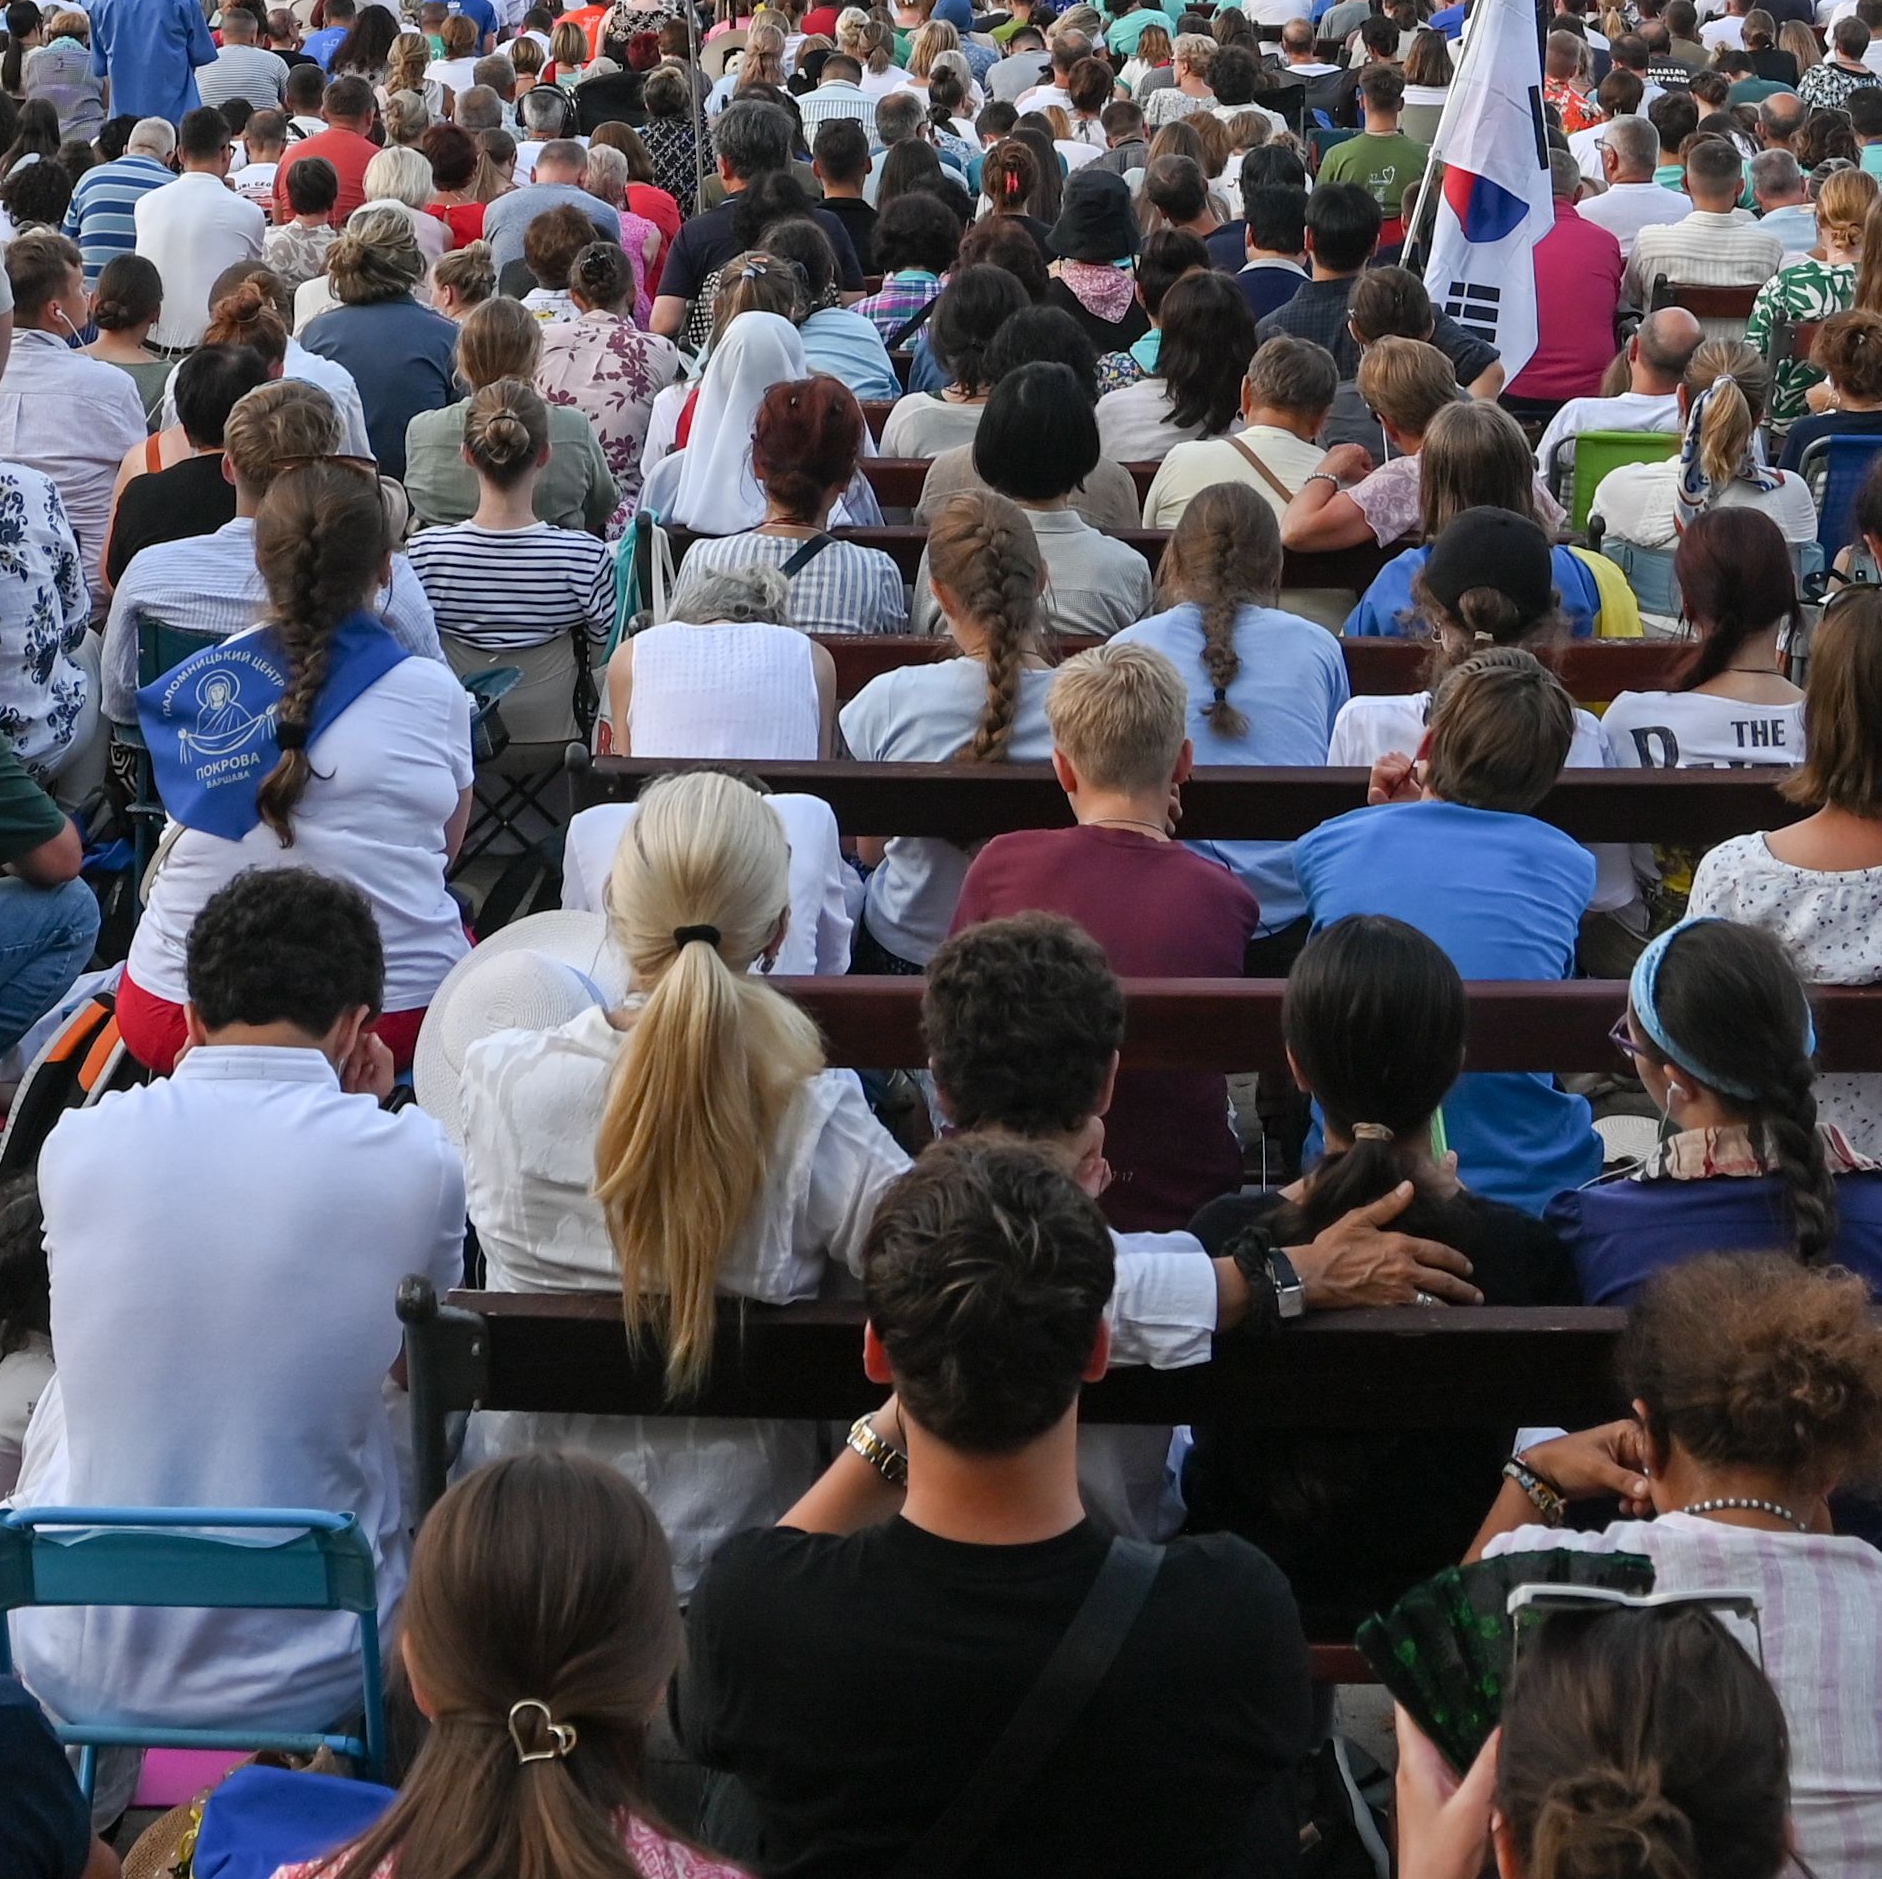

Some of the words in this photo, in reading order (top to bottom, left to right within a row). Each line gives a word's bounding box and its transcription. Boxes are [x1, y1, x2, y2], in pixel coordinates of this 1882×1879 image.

[162, 650, 251, 717] ПАЛОМНИЦЬКИЙ
[251, 656, 285, 688] ЦЕНТР
[1730, 719, 1786, 748] THE
[196, 752, 260, 781] ПОКРОВА
[206, 770, 250, 789] ВАРШАВА
